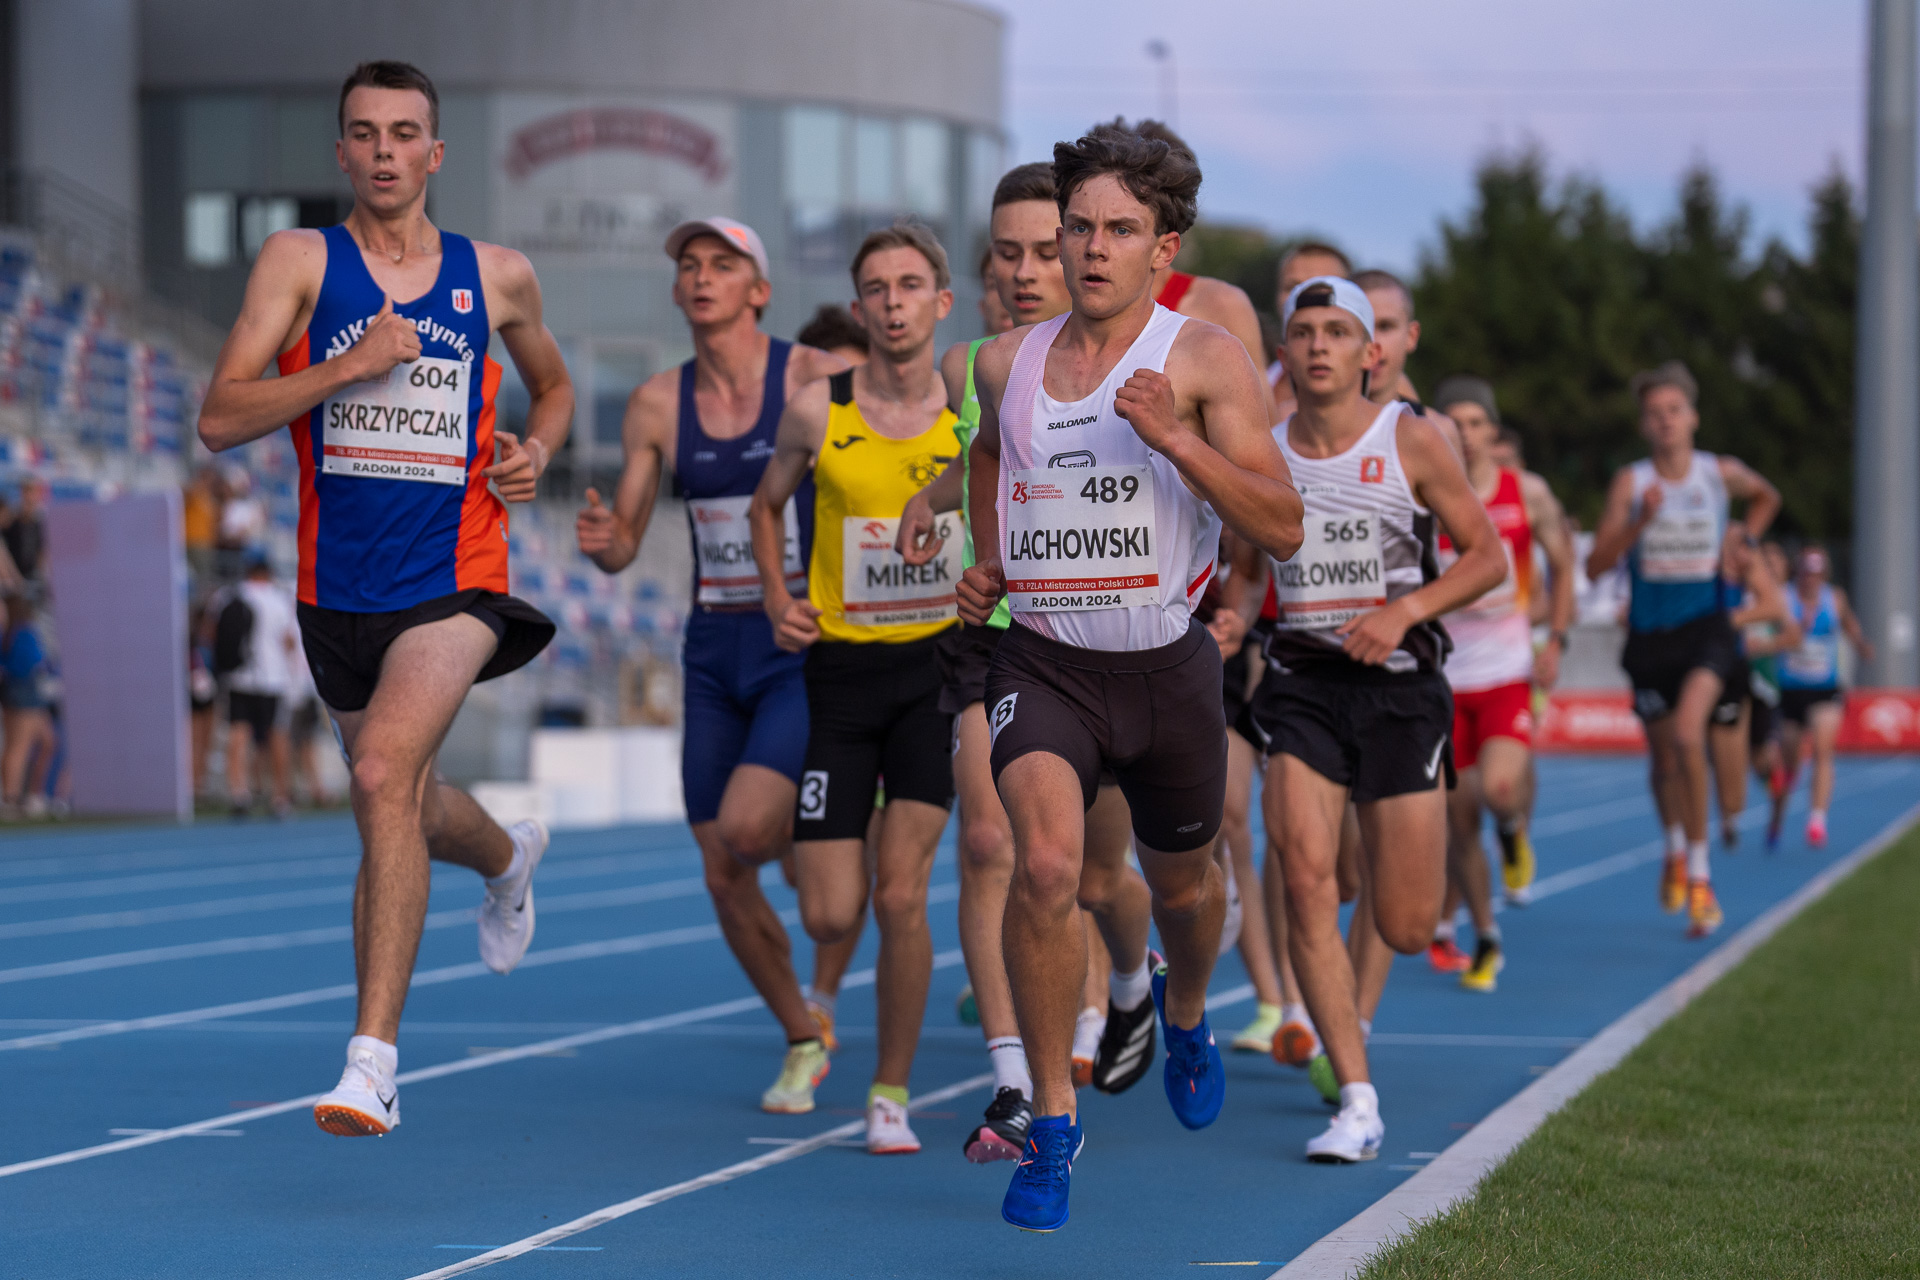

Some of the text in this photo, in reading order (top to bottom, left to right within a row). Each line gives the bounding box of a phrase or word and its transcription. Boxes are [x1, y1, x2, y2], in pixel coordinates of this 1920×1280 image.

[410, 364, 458, 392] 604
[329, 402, 462, 440] SKRZYPCZAK
[1047, 415, 1098, 430] SALOMON
[352, 462, 435, 477] RADOM 2024
[1080, 475, 1139, 504] 489
[1010, 526, 1150, 561] LACHOWSKI
[1324, 519, 1369, 543] 565
[866, 557, 950, 588] MIREK
[1016, 577, 1145, 590] 78. PZLA Mistrzostwa Polski U20
[1032, 594, 1122, 608] RADOM 2024
[995, 699, 1013, 728] 8
[801, 777, 823, 813] 3
